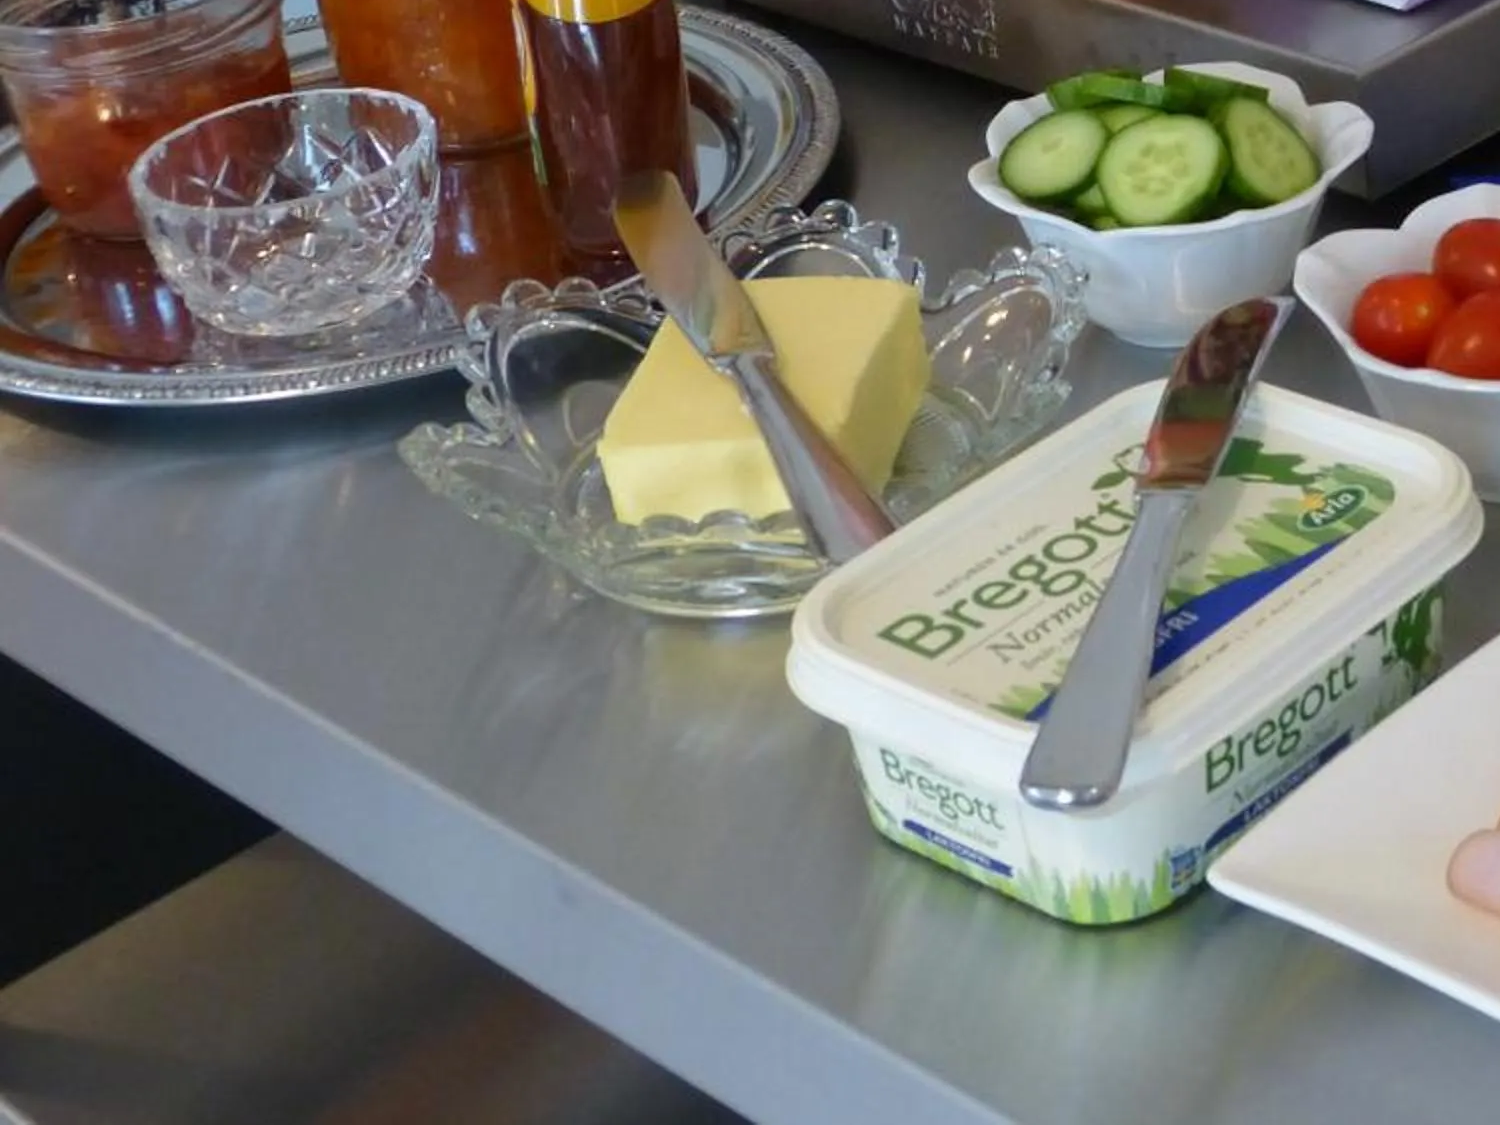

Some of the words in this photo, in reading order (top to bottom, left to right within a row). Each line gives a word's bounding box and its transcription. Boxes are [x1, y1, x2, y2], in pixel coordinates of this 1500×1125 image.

[1311, 490, 1358, 527] Arla
[876, 495, 1139, 661] Bregott
[1204, 655, 1358, 795] Bregott
[879, 747, 1005, 831] Bregott
